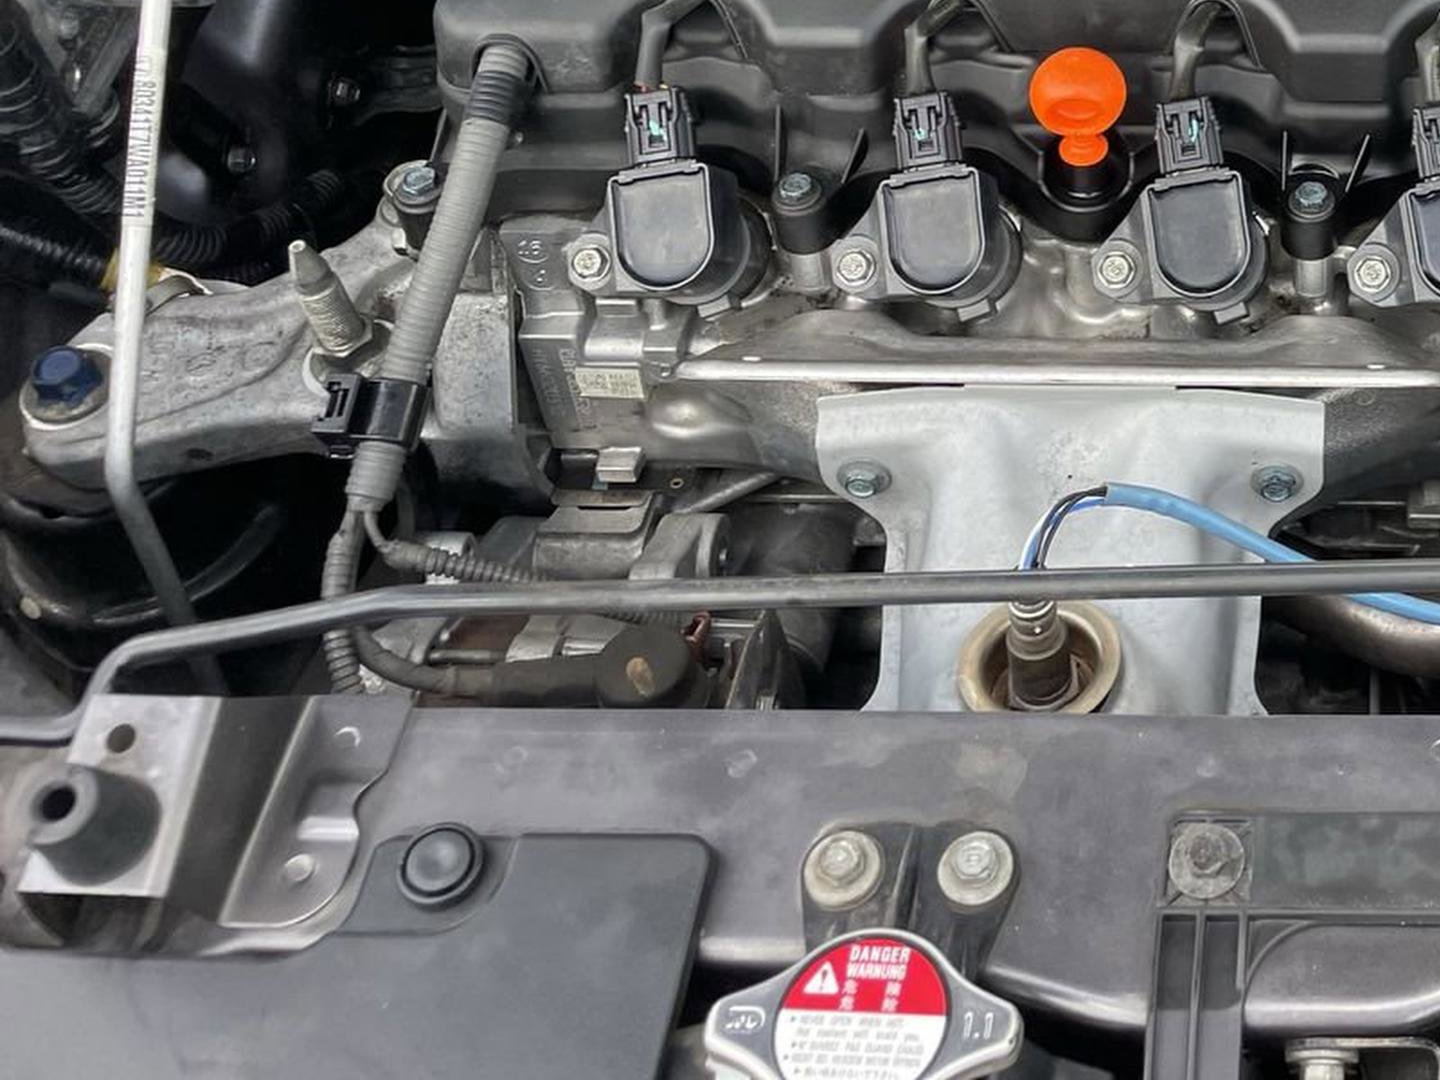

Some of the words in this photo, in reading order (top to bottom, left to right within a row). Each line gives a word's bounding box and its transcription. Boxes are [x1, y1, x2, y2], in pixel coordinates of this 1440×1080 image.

[849, 944, 911, 963] DANGER
[847, 962, 907, 981] WARNUNG
[963, 1011, 993, 1040] 1.1
